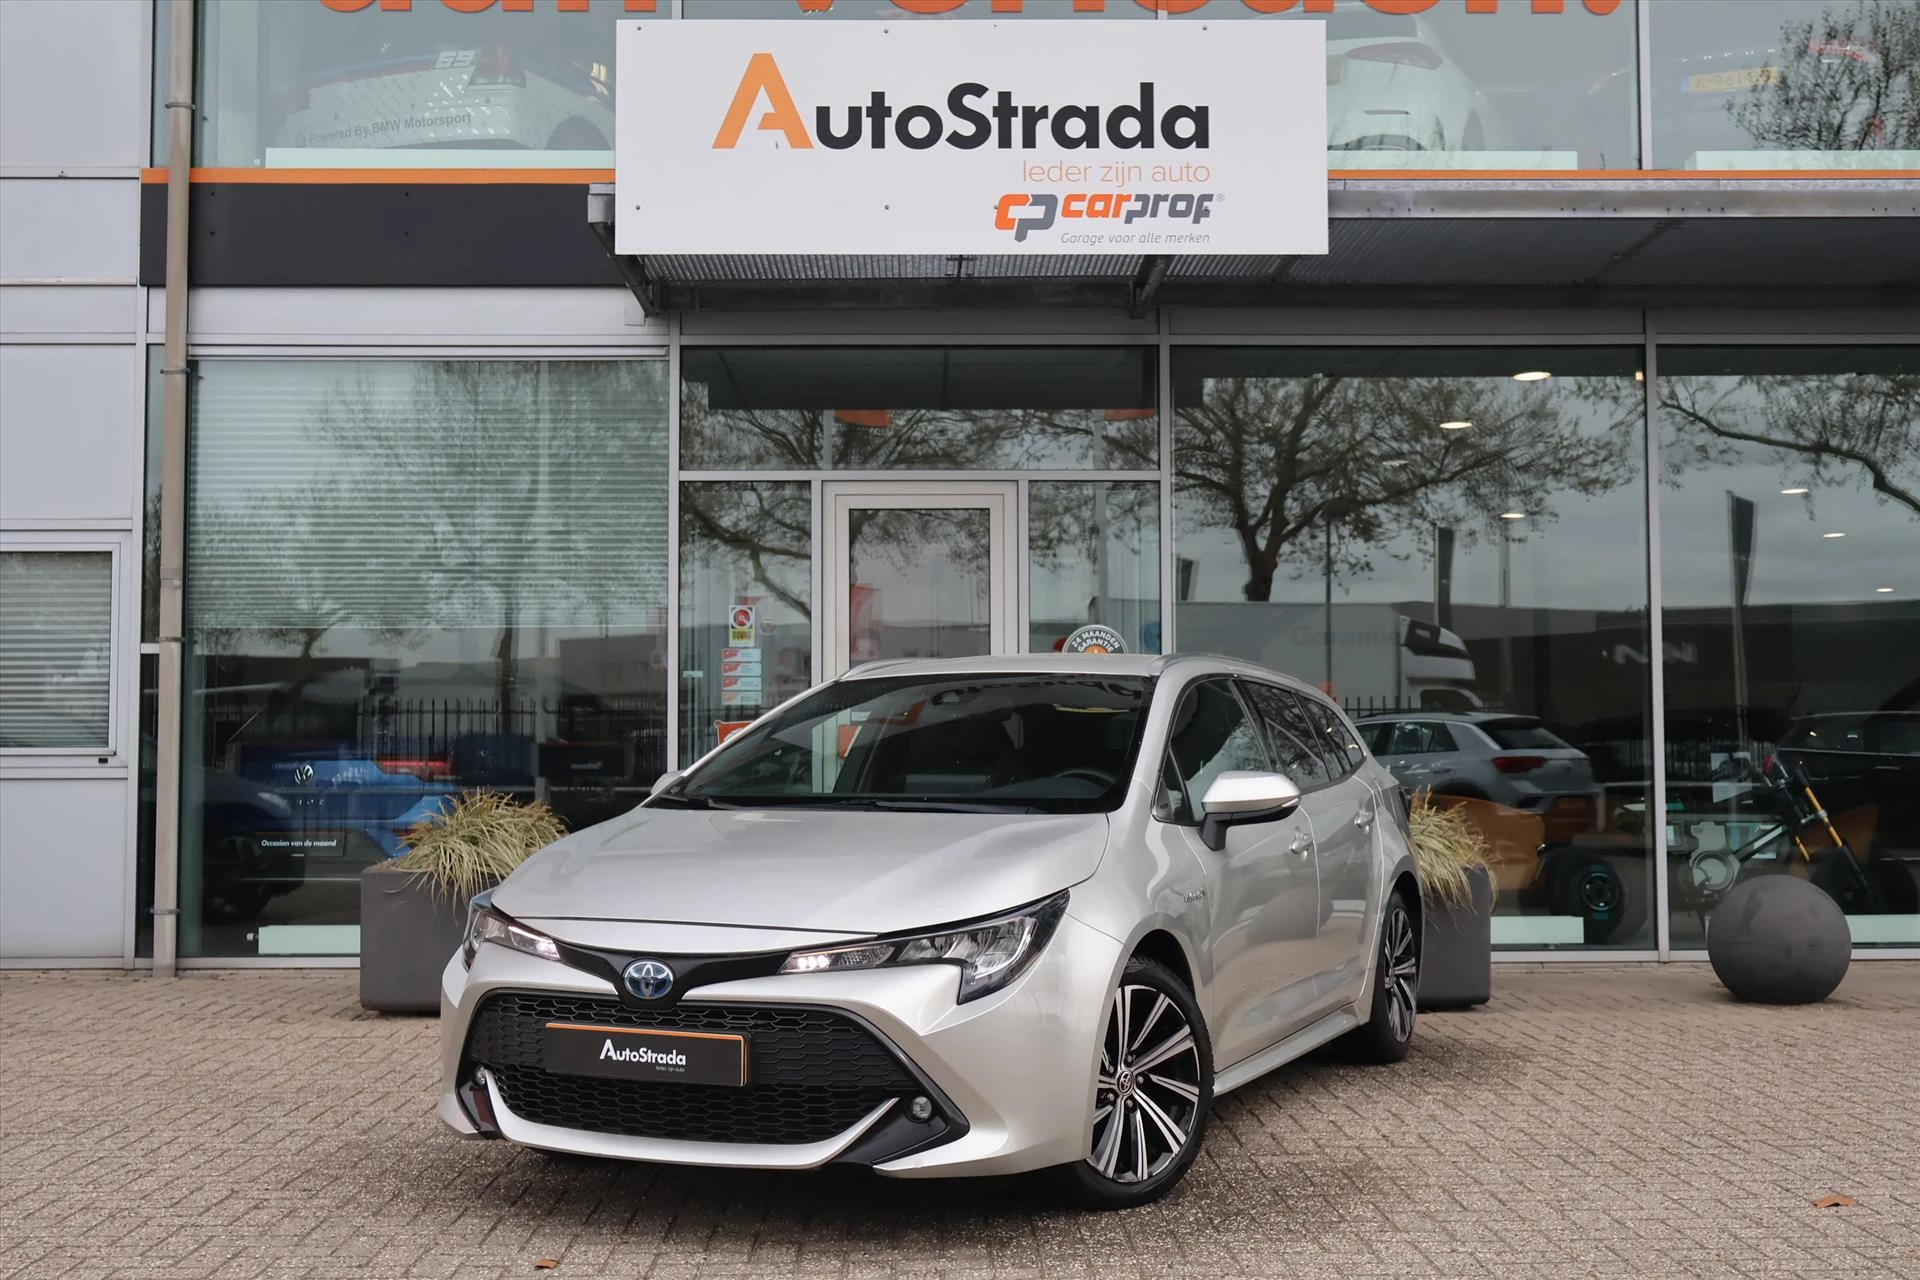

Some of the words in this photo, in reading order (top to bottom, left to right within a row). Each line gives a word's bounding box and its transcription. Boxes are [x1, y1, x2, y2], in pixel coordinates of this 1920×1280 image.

[711, 53, 1210, 150] AutoStrada
[309, 128, 351, 142] Powered
[355, 125, 369, 137] By
[373, 121, 400, 134] BMW
[404, 113, 471, 130] Motorsport
[1023, 160, 1092, 183] Ieder
[1101, 160, 1143, 188] zijn
[1152, 163, 1211, 183] auto
[1061, 232, 1104, 246] Garage
[1109, 235, 1135, 244] voor
[1139, 232, 1161, 244] alle
[1165, 232, 1210, 244] merken
[1072, 637, 1082, 648] 24
[1082, 630, 1120, 649] MAANDEN
[1077, 638, 1115, 653] GARANTIE
[261, 839, 290, 847] Occasion
[304, 839, 313, 847] de
[313, 839, 337, 847] maand
[599, 1039, 686, 1066] AutoStrada
